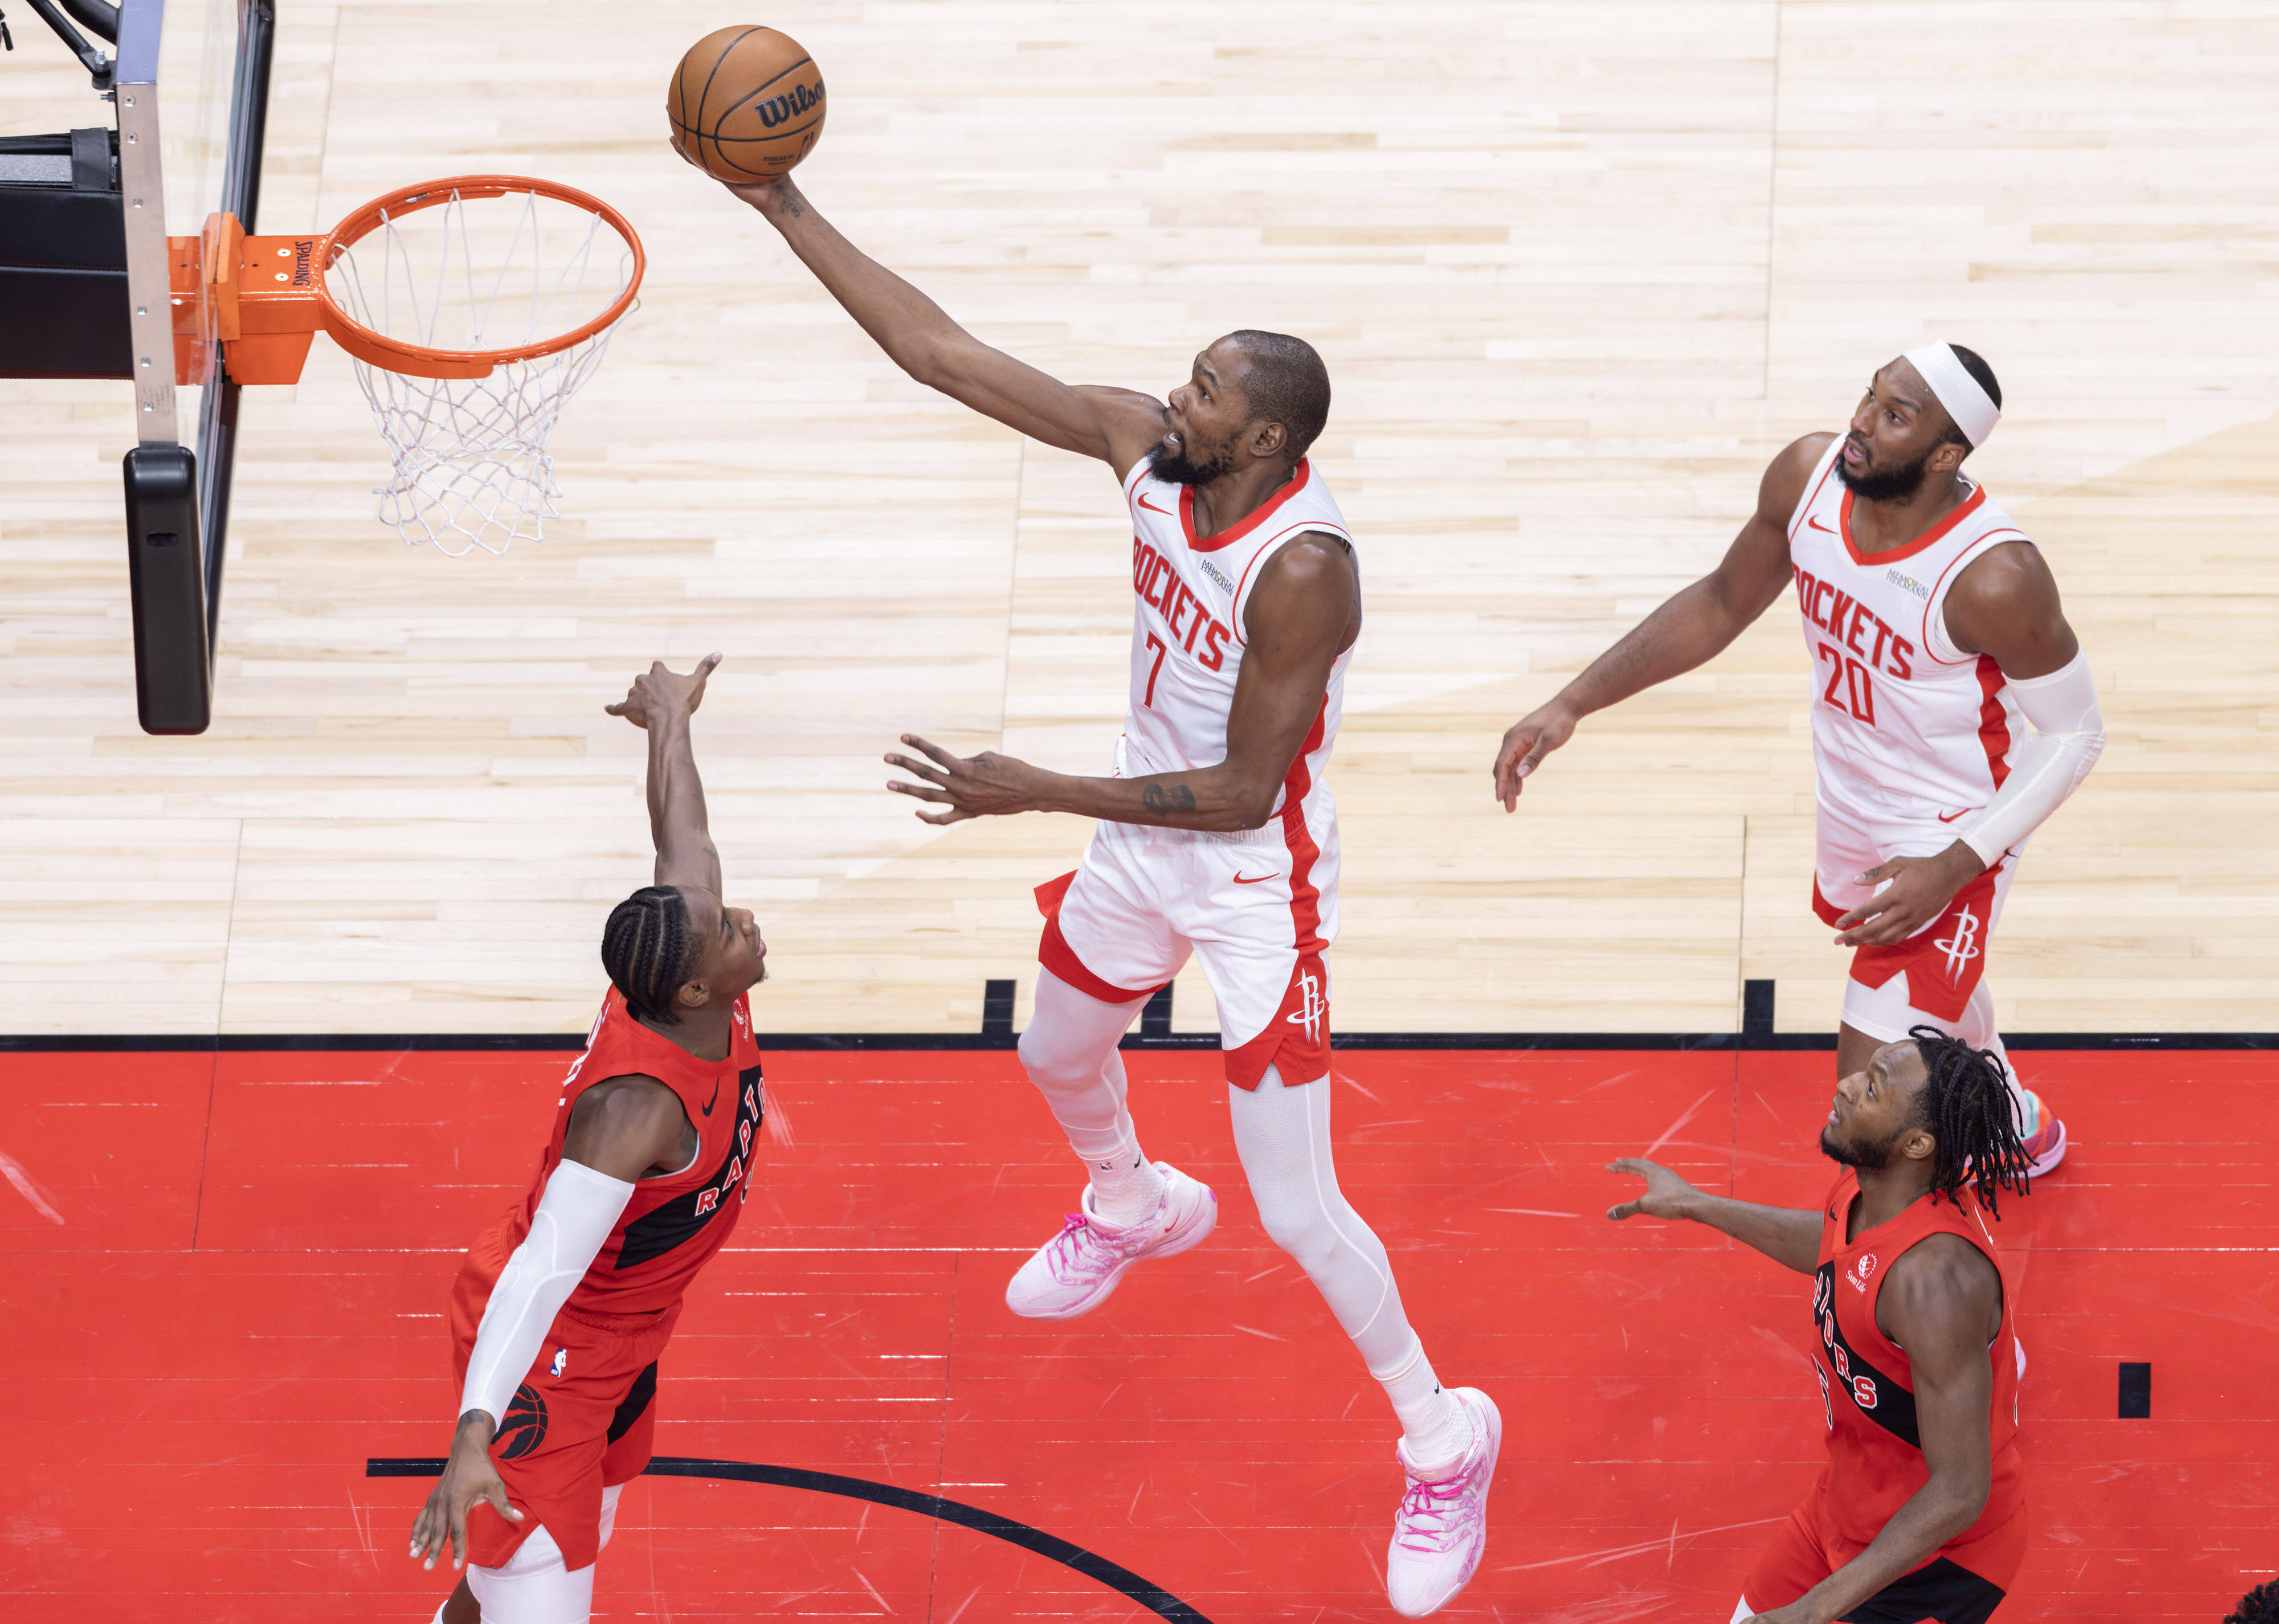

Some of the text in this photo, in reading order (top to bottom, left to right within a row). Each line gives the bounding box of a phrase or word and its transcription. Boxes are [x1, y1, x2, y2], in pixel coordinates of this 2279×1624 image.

[292, 241, 313, 286] SPALDING
[1200, 564, 1234, 597] HERMANN
[1202, 559, 1235, 593] MEMORIAL
[1885, 574, 1928, 600] HERMANN
[1887, 568, 1929, 596] MEMORIAL
[1143, 630, 1167, 710] 7
[1818, 642, 1876, 728] 20
[1846, 1269, 1866, 1295] Sun Life
